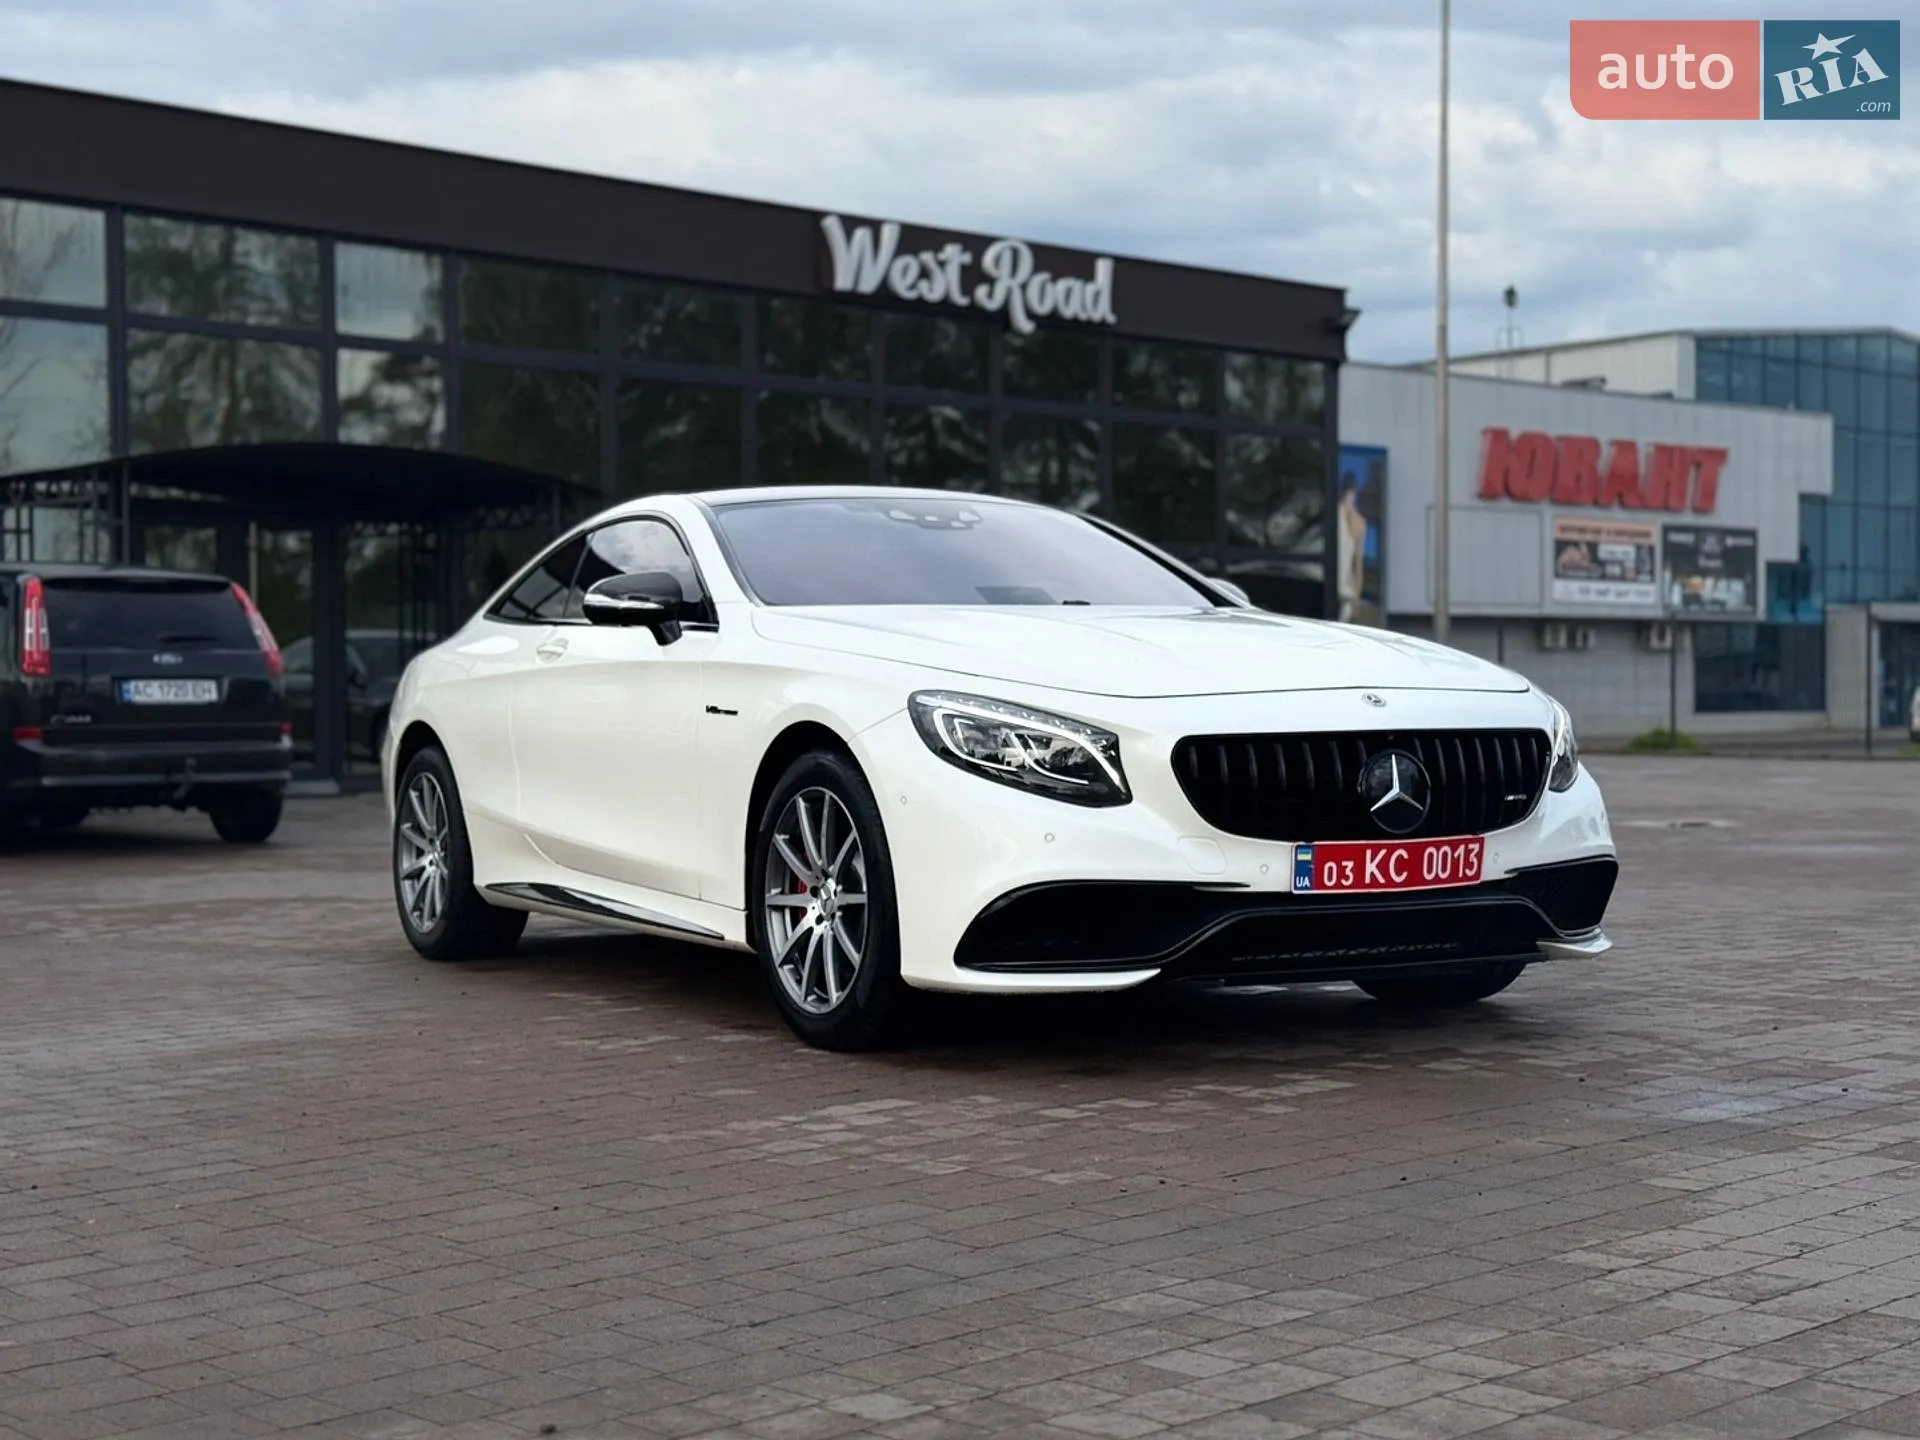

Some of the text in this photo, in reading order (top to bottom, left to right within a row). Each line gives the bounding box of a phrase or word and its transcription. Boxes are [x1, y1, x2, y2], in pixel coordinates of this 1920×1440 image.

[820, 214, 1117, 334] West Road
[1477, 426, 1729, 514] ЮВАНТ
[1295, 876, 1311, 888] UA
[1322, 842, 1480, 887] 03 KC 0013
